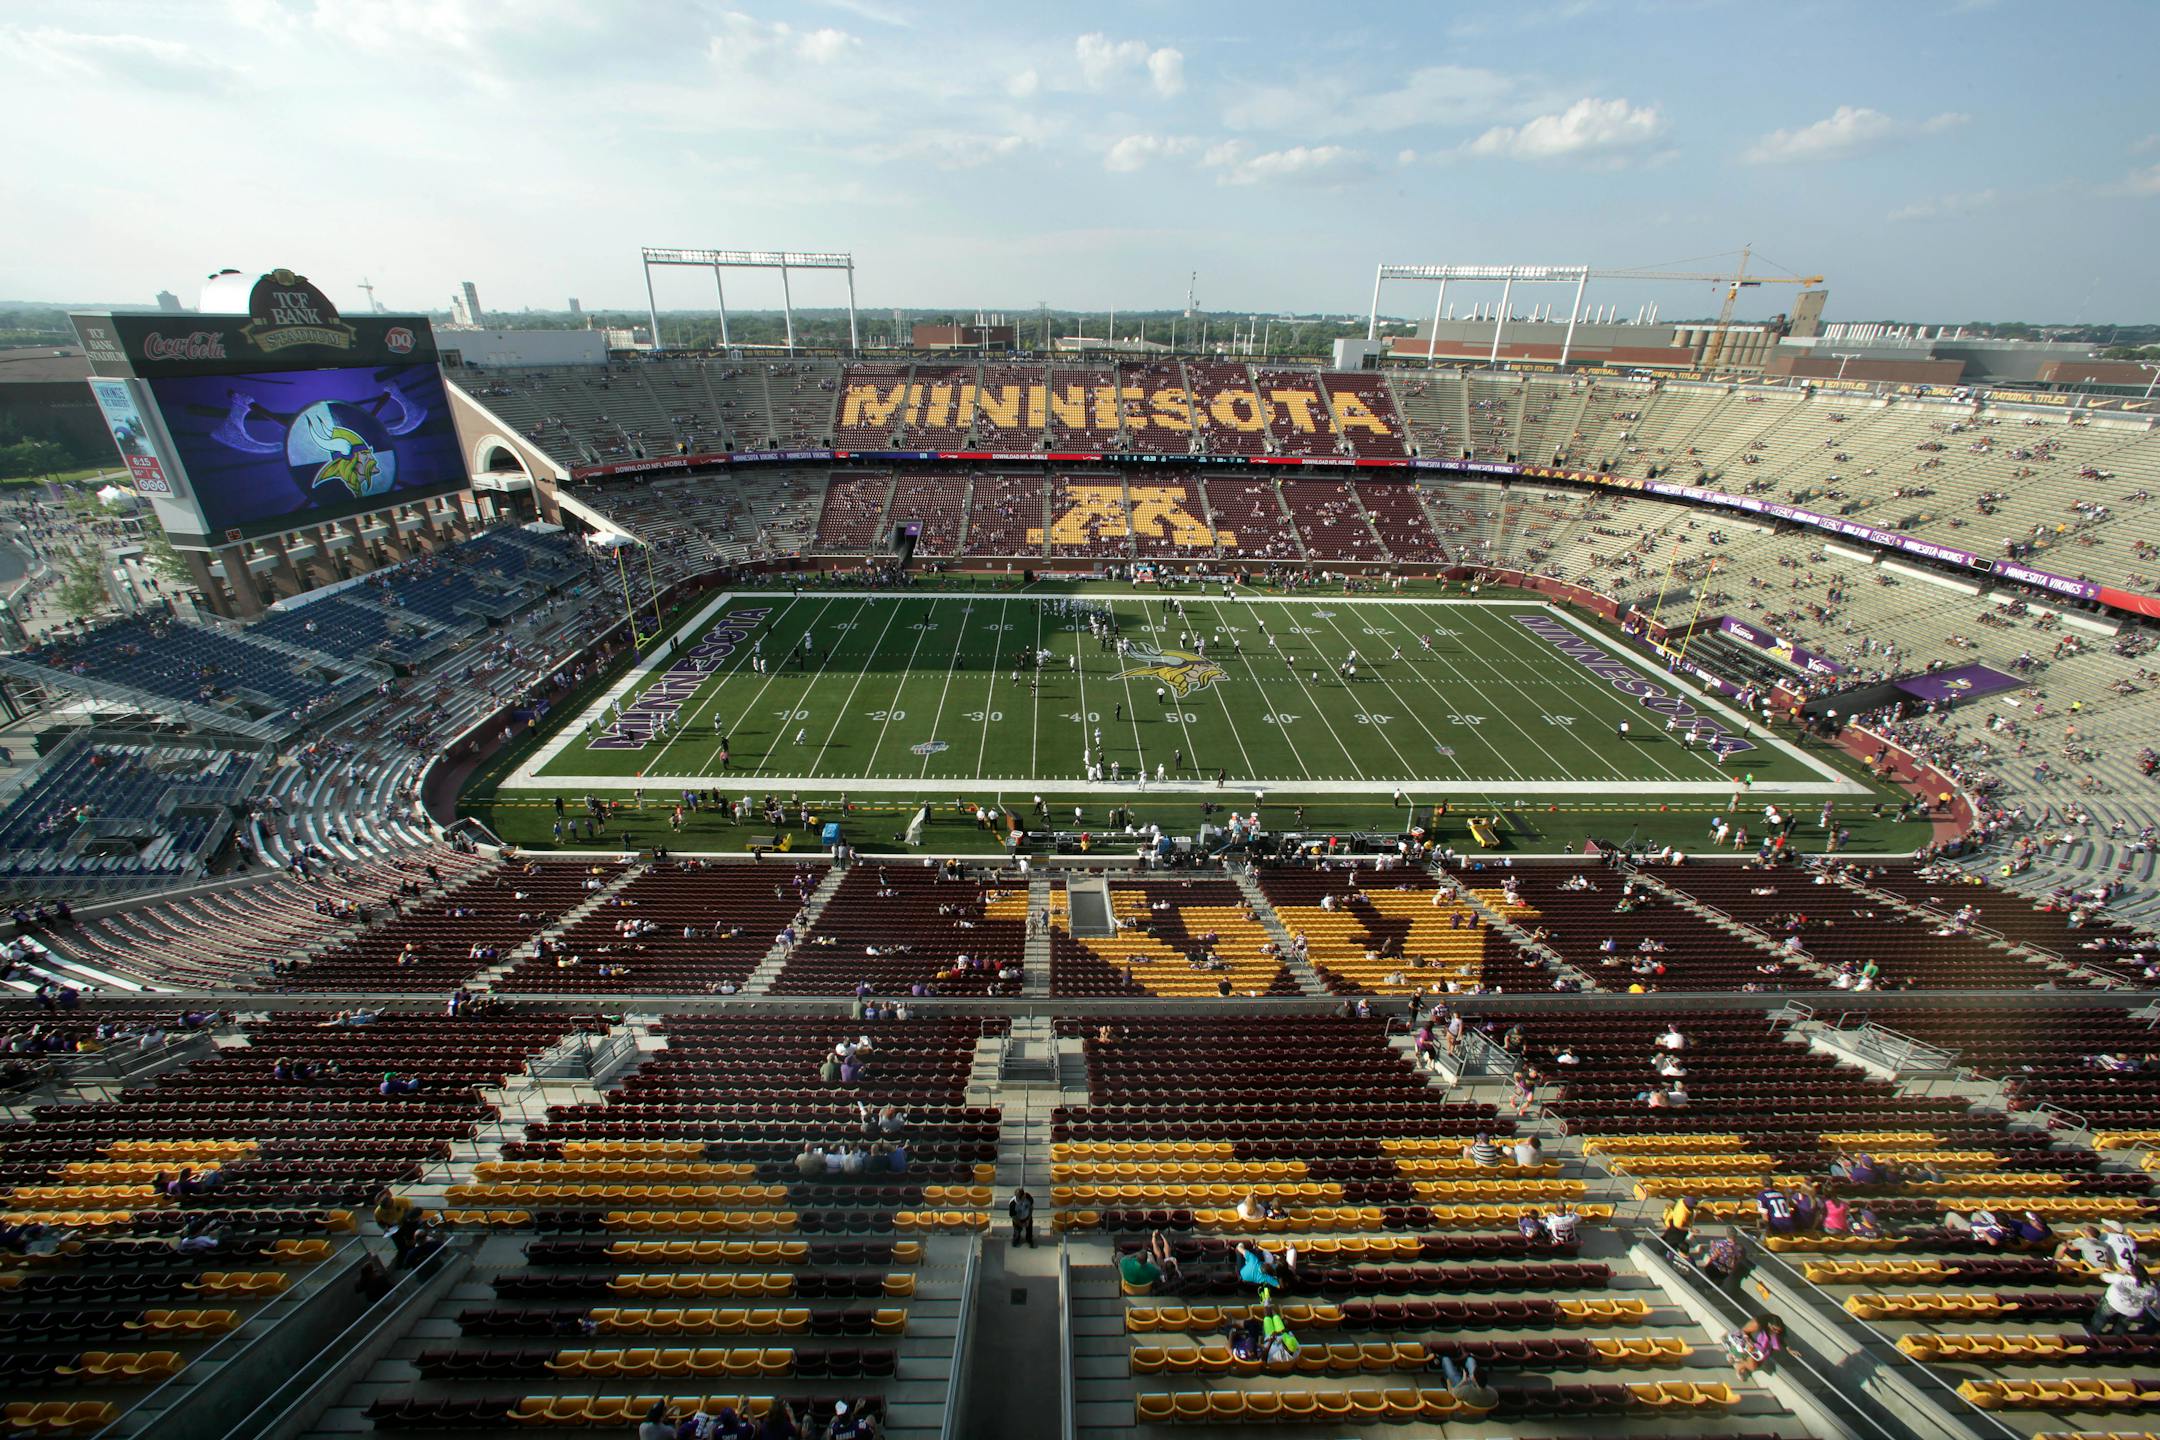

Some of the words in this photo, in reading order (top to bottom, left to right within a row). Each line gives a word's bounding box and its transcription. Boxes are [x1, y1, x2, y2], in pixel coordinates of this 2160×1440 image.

[272, 292, 310, 309] TCF
[271, 308, 323, 325] BANK
[144, 331, 226, 360] Coca-Cola
[265, 332, 341, 347] STADIUM
[389, 333, 412, 348] DQ
[1840, 381, 1868, 390] TITLES
[1991, 391, 2033, 402] NATIONAL
[2035, 394, 2068, 405] TITLES
[841, 384, 1392, 435] MINNESOTA
[615, 463, 651, 474] DOWNLOAD
[651, 461, 664, 470] NFL
[664, 459, 688, 469] MOBILE
[1468, 463, 1493, 472] MINNESOTA
[1494, 465, 1514, 473] VIKINGS
[1903, 540, 1937, 557] MINNESOTA
[1938, 548, 1966, 564] VIKINGS
[2005, 566, 2048, 586] MINNESOTA
[2049, 577, 2084, 595] VIKINGS
[779, 710, 809, 721] 10
[872, 710, 906, 721] 20
[971, 711, 1003, 722] 30
[1069, 712, 1100, 723] 40
[1165, 713, 1197, 724] 50
[1262, 713, 1293, 724] 40
[1355, 713, 1387, 725] 30
[1447, 714, 1482, 725] 20
[1541, 714, 1572, 726] 10
[1770, 1198, 1791, 1218] 10
